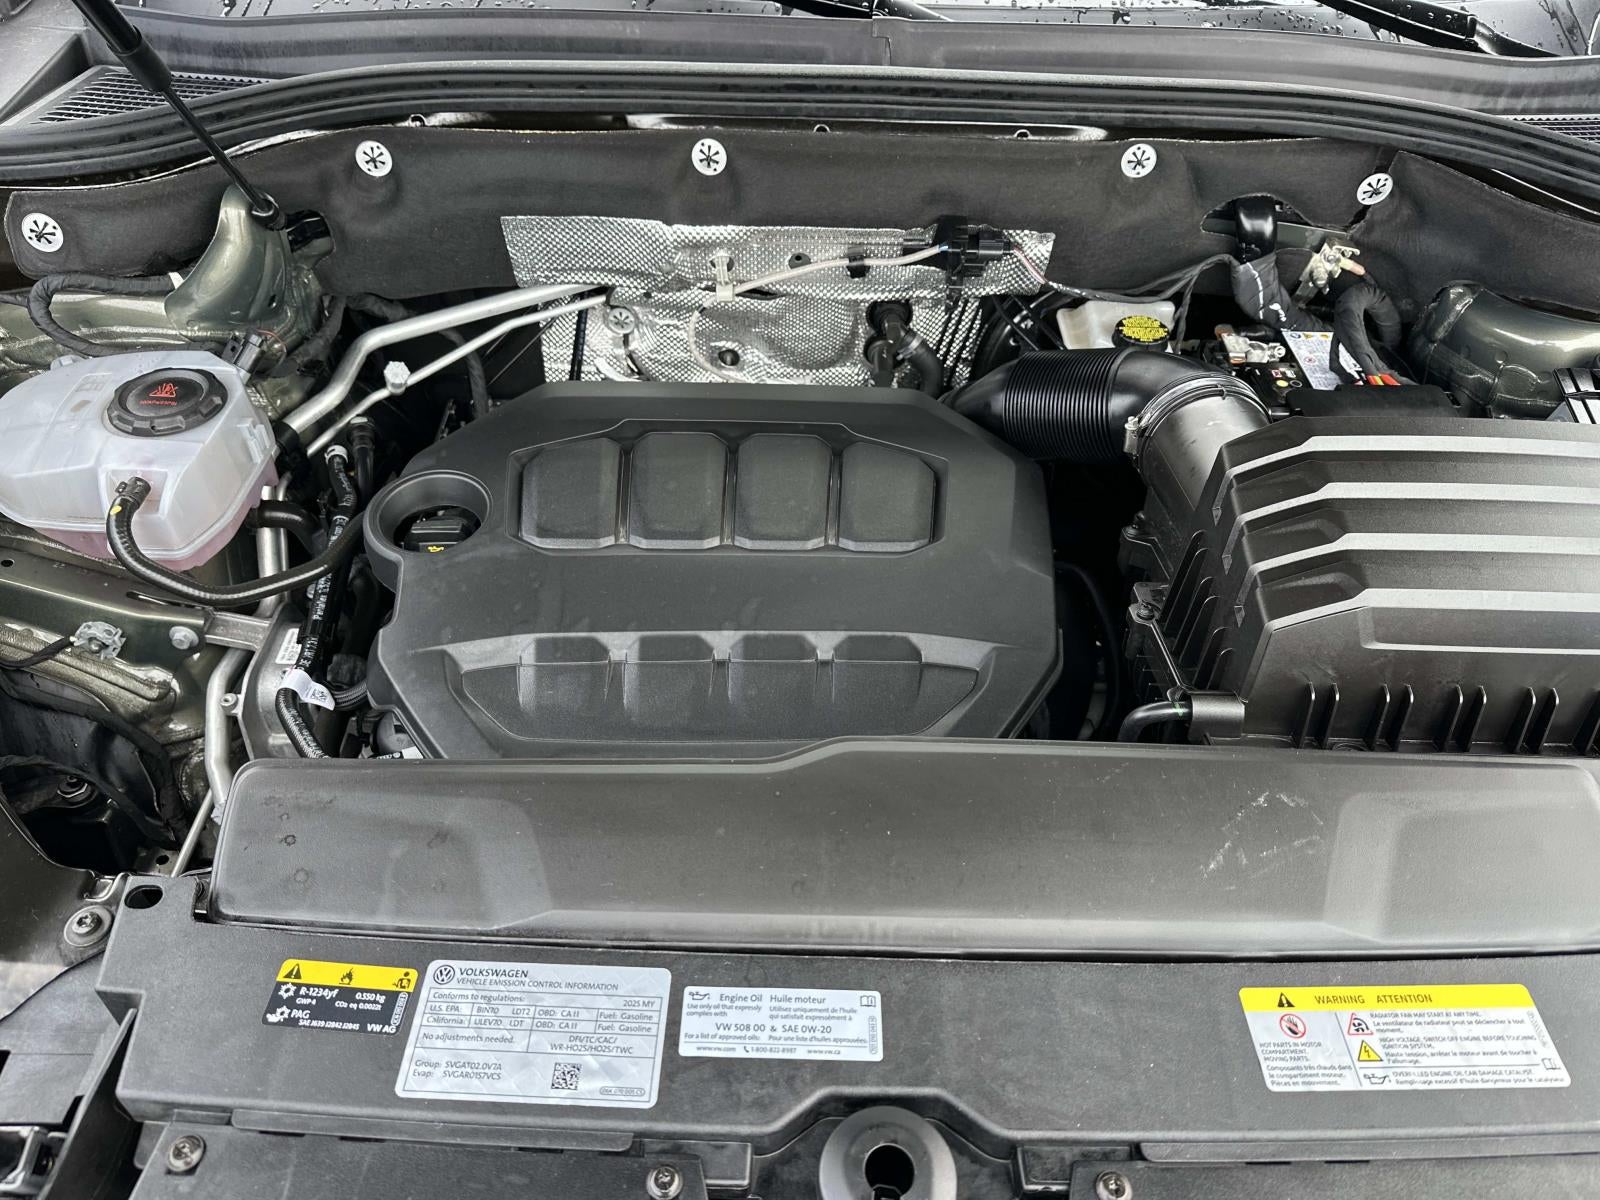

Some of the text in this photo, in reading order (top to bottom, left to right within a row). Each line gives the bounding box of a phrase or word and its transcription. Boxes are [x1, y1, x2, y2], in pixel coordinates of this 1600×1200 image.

[460, 968, 528, 978] VOLKSWAGEN
[488, 979, 526, 987] EMISSION
[528, 980, 563, 989] CONTROL
[564, 982, 619, 991] INFORMATION
[300, 986, 386, 1003] R-1234yf 0.550 kg
[433, 992, 469, 1000] Conforms
[720, 994, 762, 1004] Engine Oil
[770, 994, 792, 1003] Huile
[1314, 994, 1432, 1004] WARNING ATTENTION
[700, 1002, 712, 1010] only
[290, 1009, 310, 1019] PAG
[538, 1009, 557, 1017] OBD:
[560, 1010, 572, 1018] CA
[620, 1012, 653, 1021] Gasoline
[367, 1024, 396, 1034] VW AG
[474, 1018, 502, 1026] ULEV70
[536, 1020, 556, 1028] OBD:
[619, 1024, 652, 1033] Gasoline
[715, 1022, 732, 1031] VW
[734, 1024, 751, 1032] 508
[753, 1024, 766, 1032] 00
[782, 1024, 799, 1033] SAE
[801, 1026, 832, 1034] 0W-20
[422, 1032, 434, 1040] No
[434, 1033, 482, 1042] adjustments
[414, 1060, 441, 1069] Group:
[412, 1069, 434, 1078] Evap:
